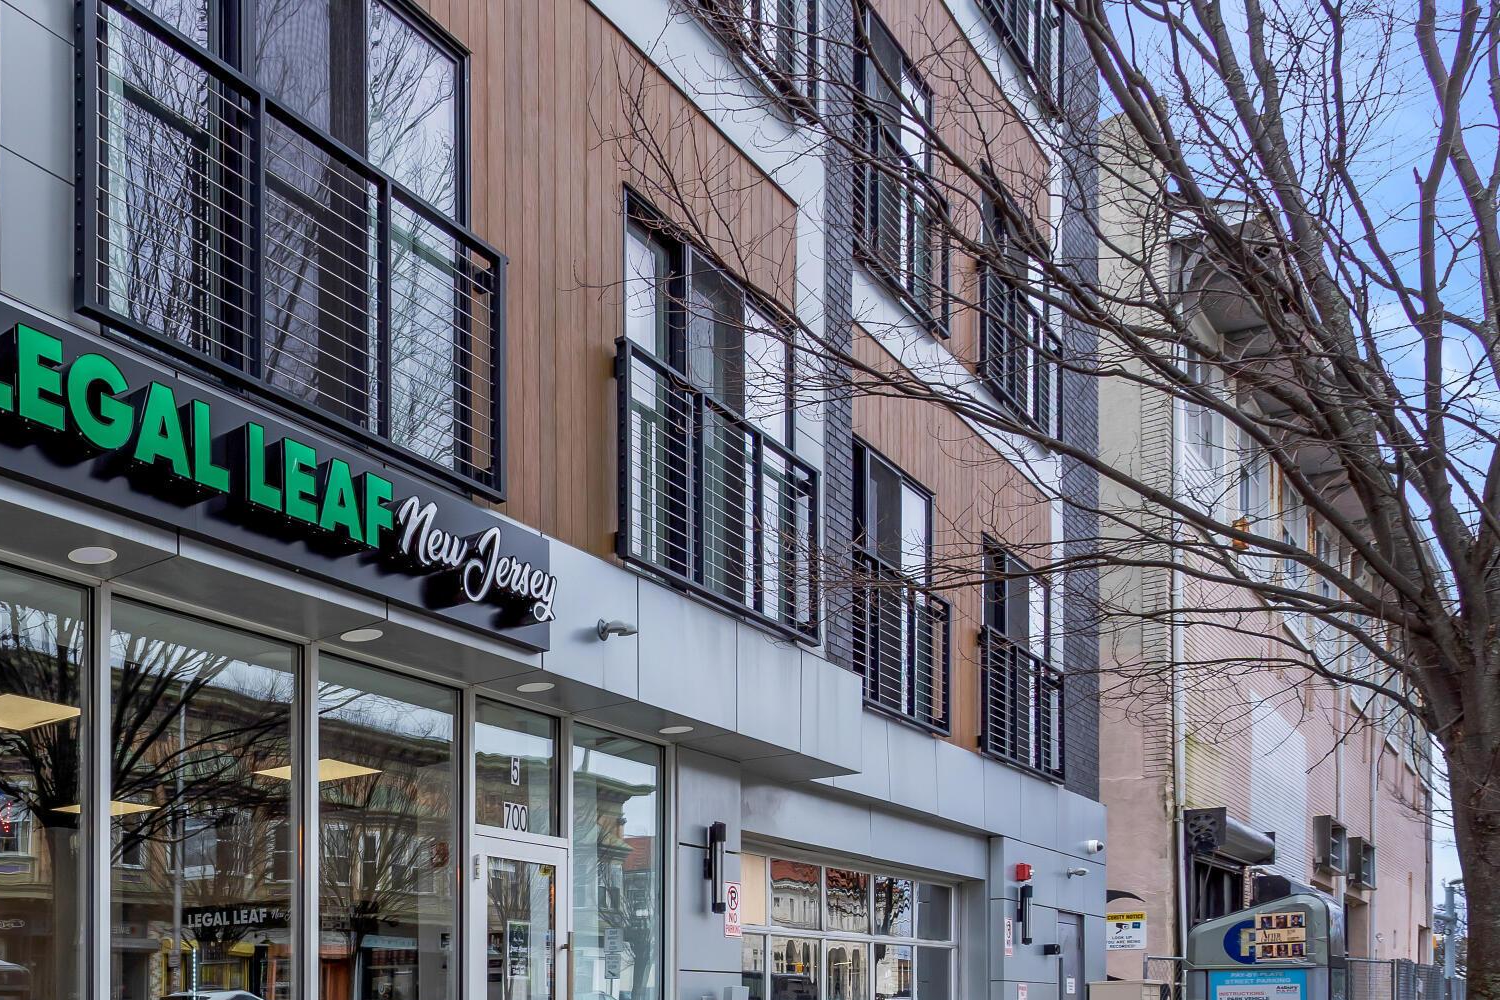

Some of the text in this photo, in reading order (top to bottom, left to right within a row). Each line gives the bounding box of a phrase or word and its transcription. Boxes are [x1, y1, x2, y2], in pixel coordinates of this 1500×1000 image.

[245, 421, 394, 549] LEAF
[398, 494, 468, 566] New
[463, 526, 558, 622] Jersey
[512, 757, 519, 784] 5
[504, 803, 528, 832] 700
[188, 911, 230, 928] LEGAL
[233, 908, 267, 925] LEAF
[728, 912, 738, 923] NO
